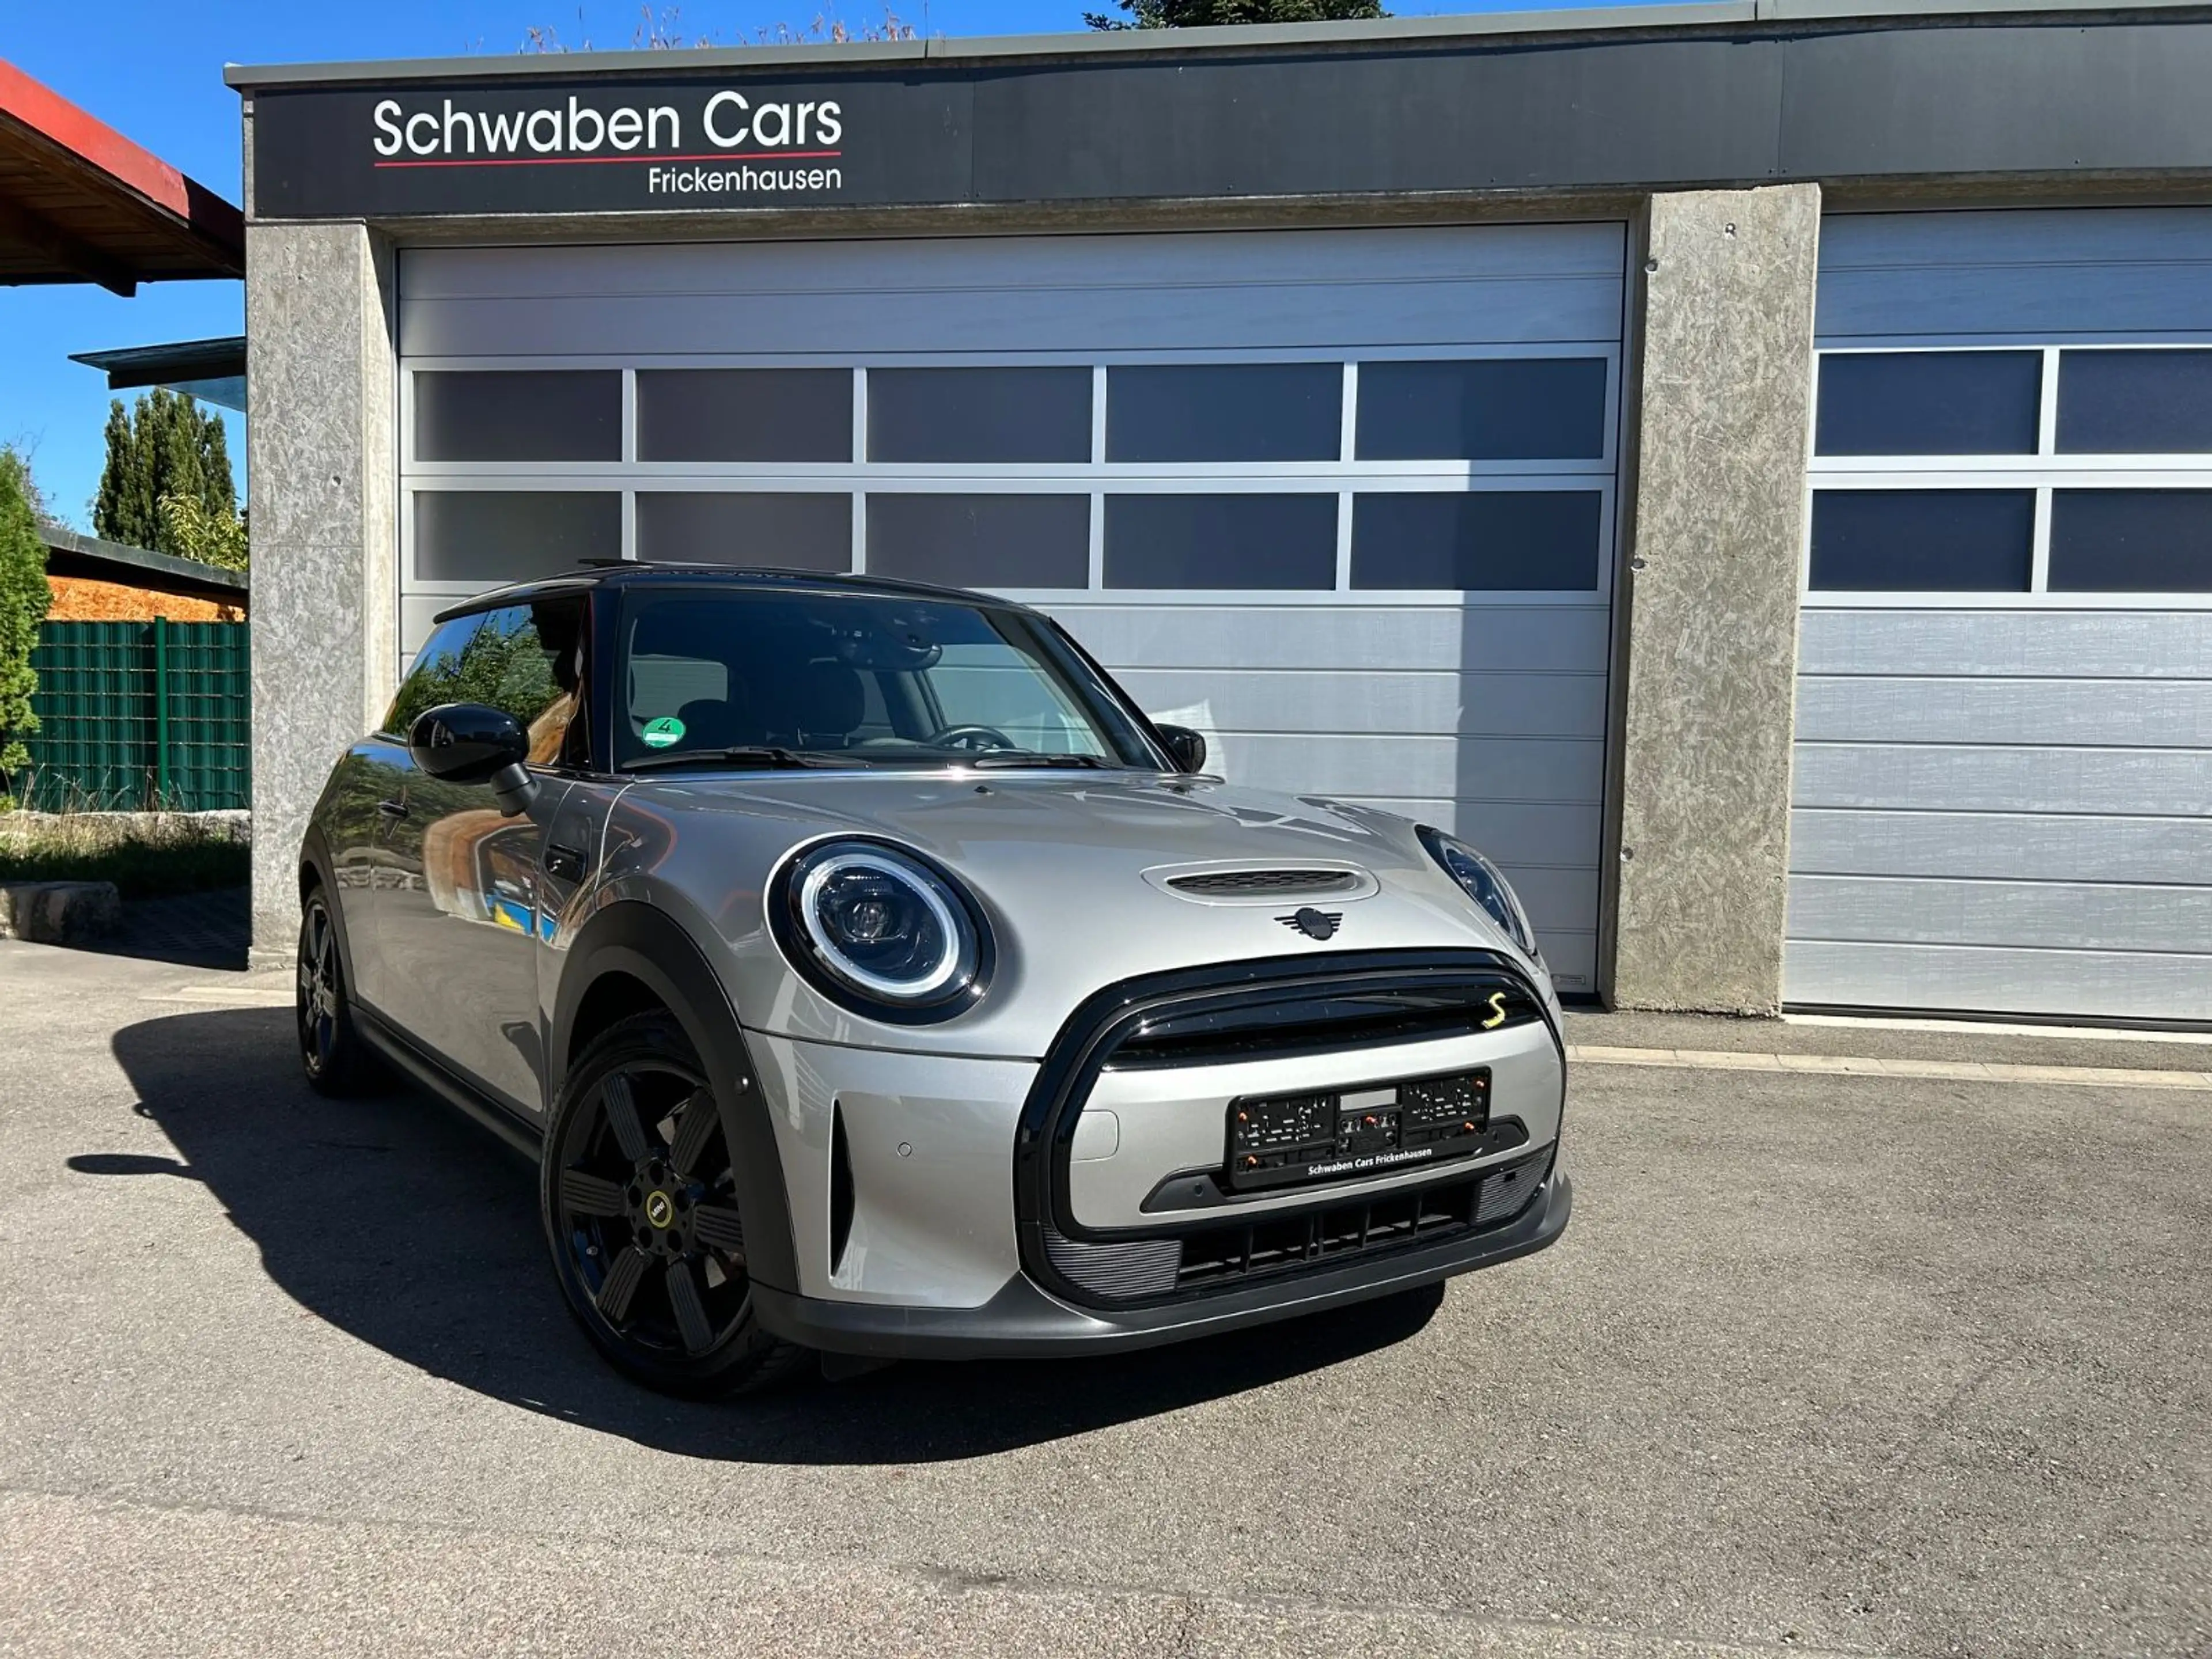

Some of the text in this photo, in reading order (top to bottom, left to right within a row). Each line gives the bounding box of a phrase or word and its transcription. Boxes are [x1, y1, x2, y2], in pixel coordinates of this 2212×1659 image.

[373, 90, 842, 156] Schwaben Cars
[649, 165, 842, 194] Frickenhausen
[657, 719, 672, 732] 4
[1481, 992, 1506, 1029] S
[1308, 1148, 1433, 1176] Schwaben Cars Frickenhausen
